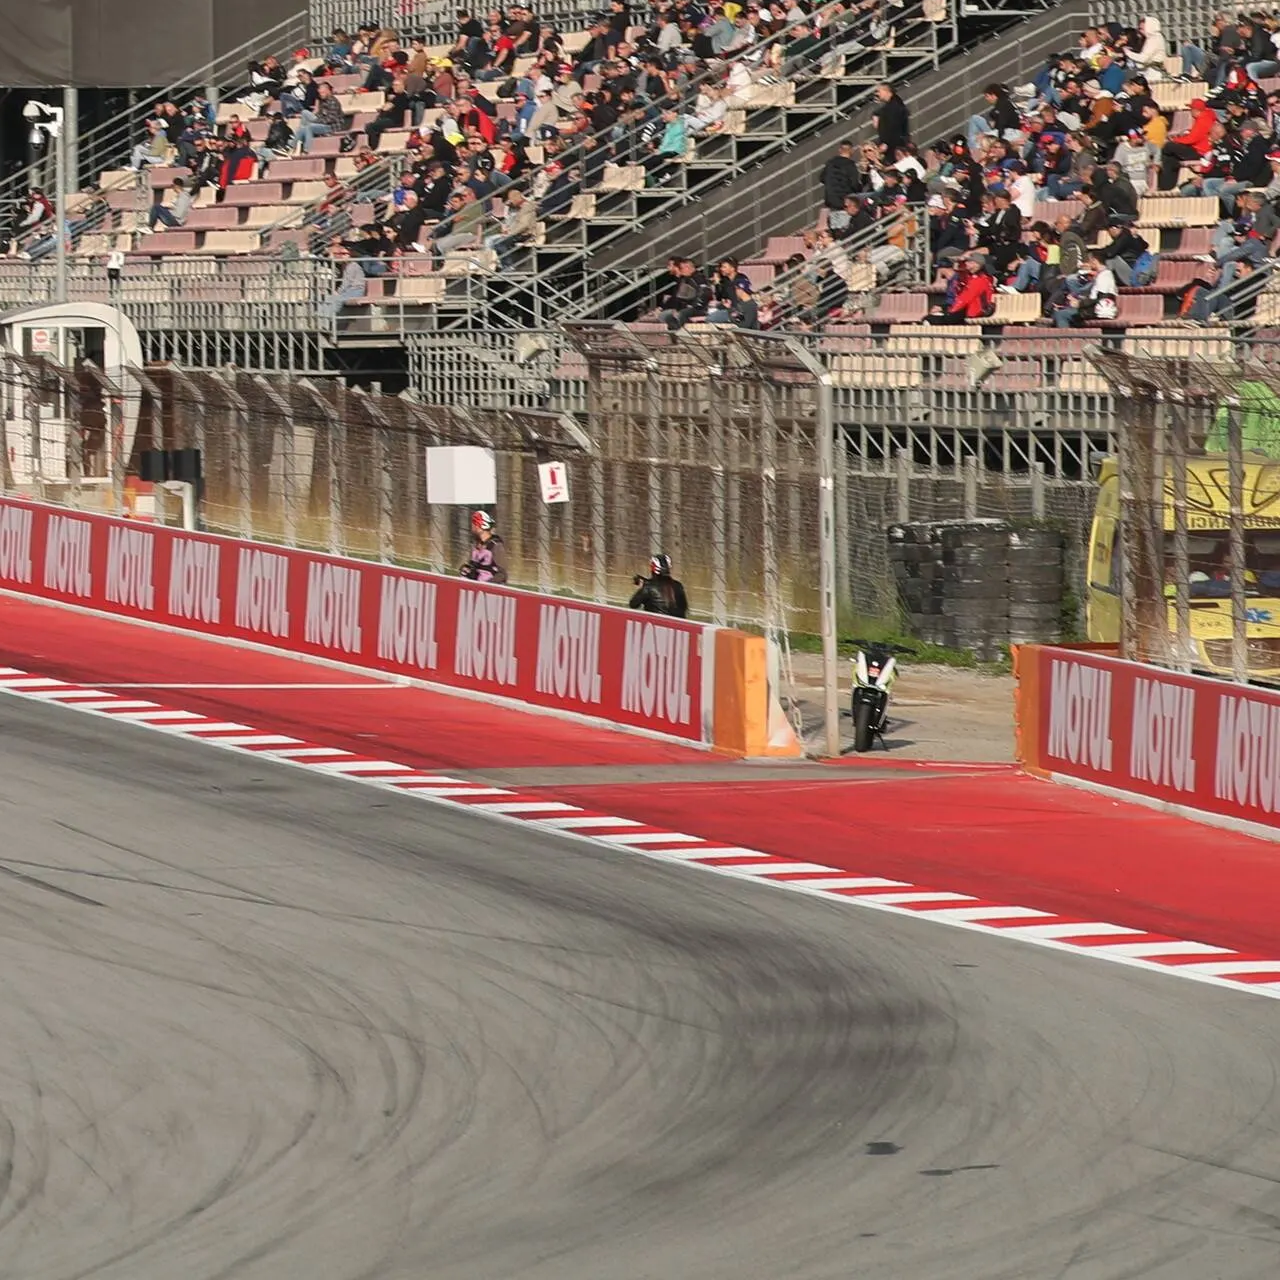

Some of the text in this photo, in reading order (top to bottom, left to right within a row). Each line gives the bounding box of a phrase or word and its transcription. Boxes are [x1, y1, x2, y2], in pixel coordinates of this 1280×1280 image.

[44, 515, 92, 597] MOTUL
[105, 526, 155, 610] MOTUL
[168, 538, 221, 624] MOTUL
[235, 549, 290, 637] MOTUL
[305, 561, 362, 654] MOTUL
[378, 576, 438, 670] MOTUL
[455, 590, 518, 686] MOTUL
[536, 605, 602, 703] MOTUL
[622, 620, 691, 725] MOTUL
[1048, 659, 1113, 773] MOTUL
[1130, 676, 1196, 793] MOTUL
